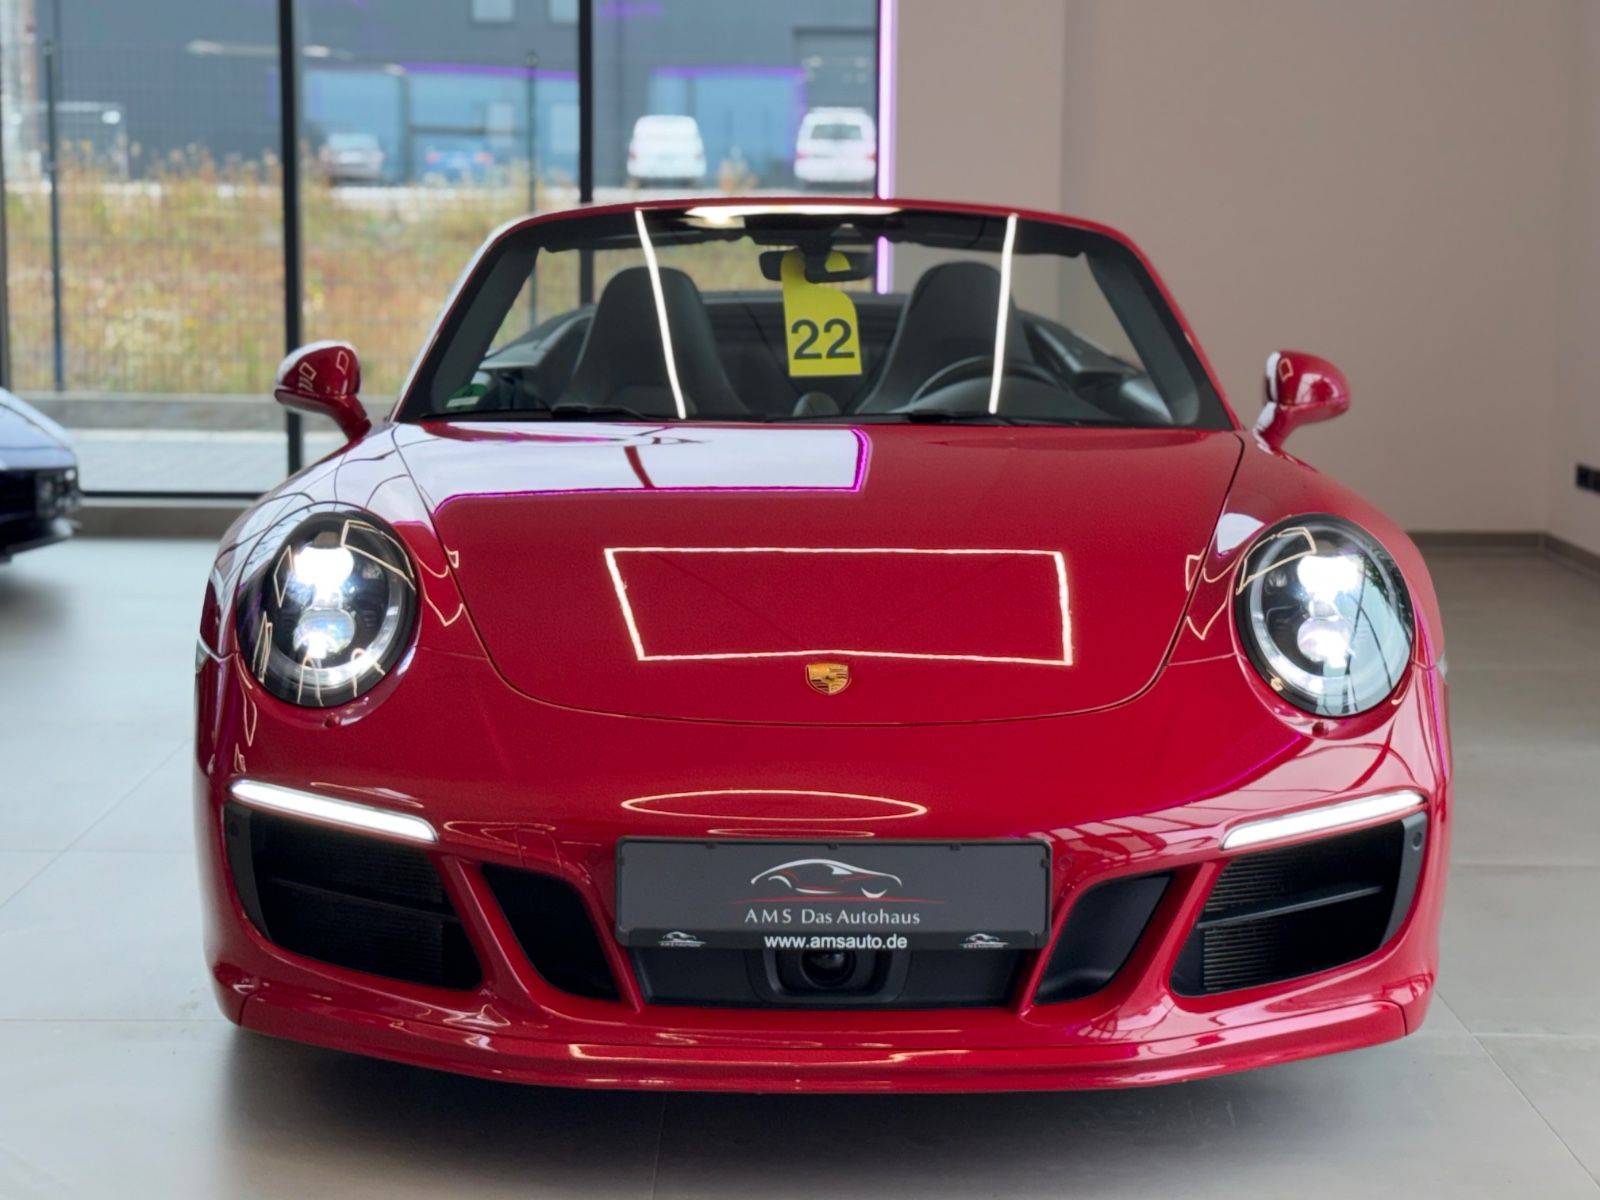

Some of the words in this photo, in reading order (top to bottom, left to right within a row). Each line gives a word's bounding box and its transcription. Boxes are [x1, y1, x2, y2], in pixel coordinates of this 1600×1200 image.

[791, 318, 855, 360] 22
[744, 908, 793, 924] AMS
[801, 908, 832, 924] Das
[836, 908, 921, 925] Autohaus
[764, 934, 908, 949] www.amsauto.de
